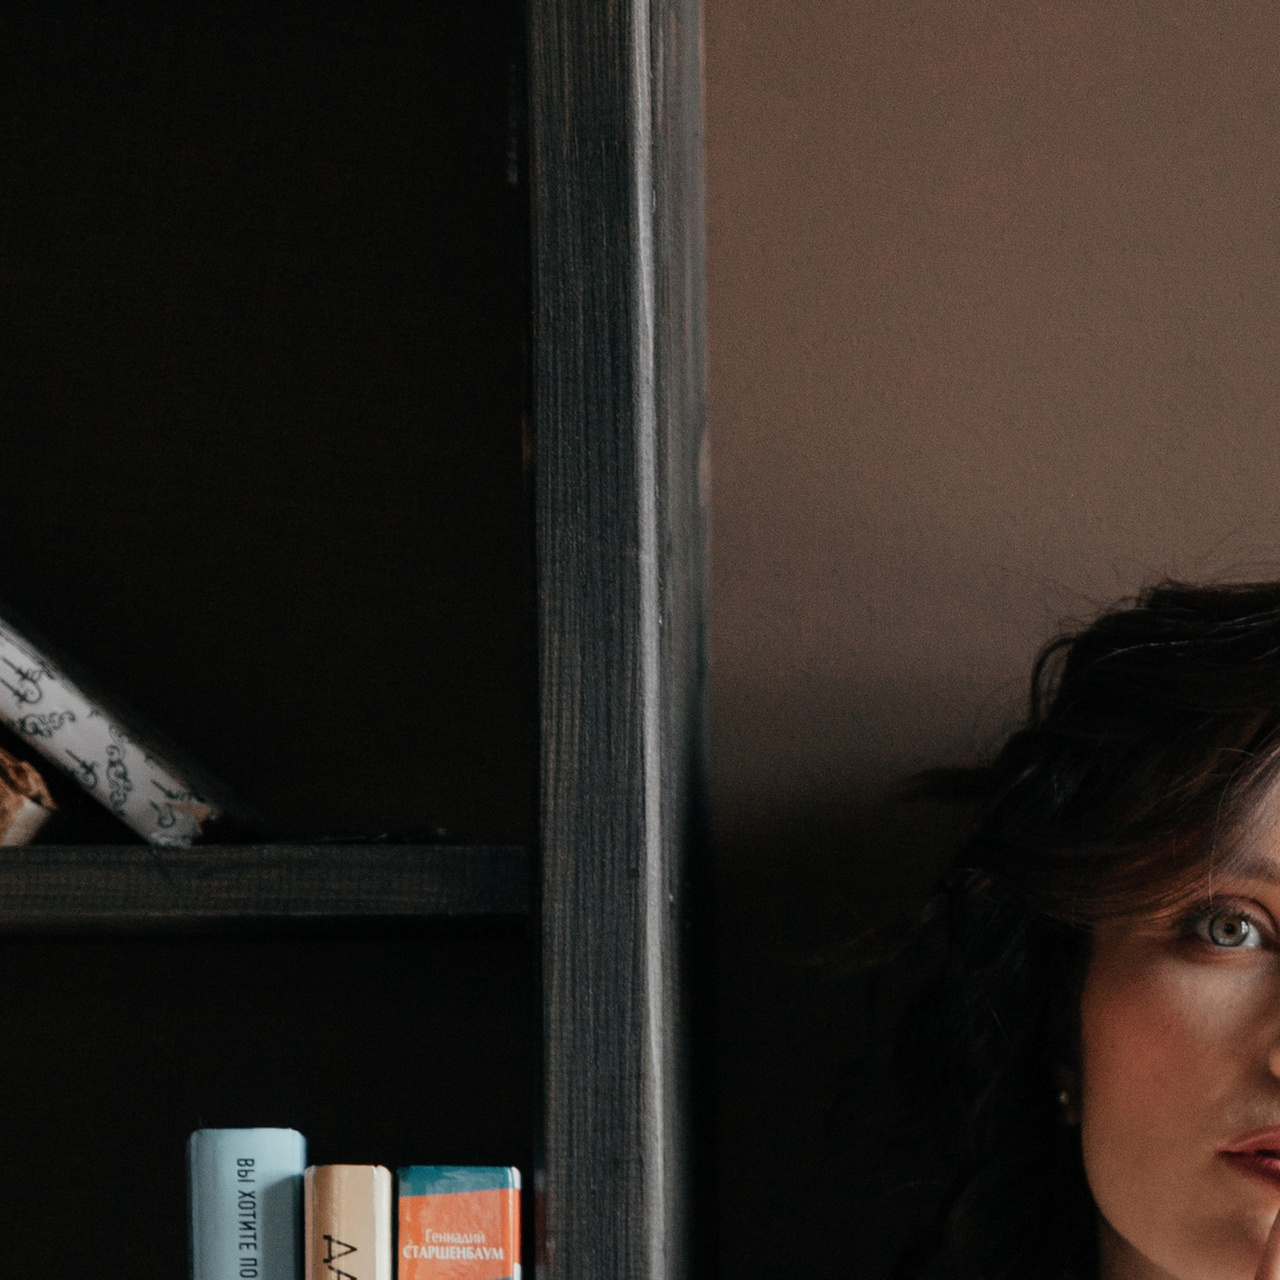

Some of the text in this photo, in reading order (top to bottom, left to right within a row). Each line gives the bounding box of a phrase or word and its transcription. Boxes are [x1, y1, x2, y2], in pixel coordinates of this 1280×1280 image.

[236, 1157, 255, 1183] ВЫ
[237, 1190, 258, 1250] ХОТИТЕ
[425, 1228, 486, 1245] Геннадий
[402, 1244, 505, 1261] СТАРШЕНБАУМ
